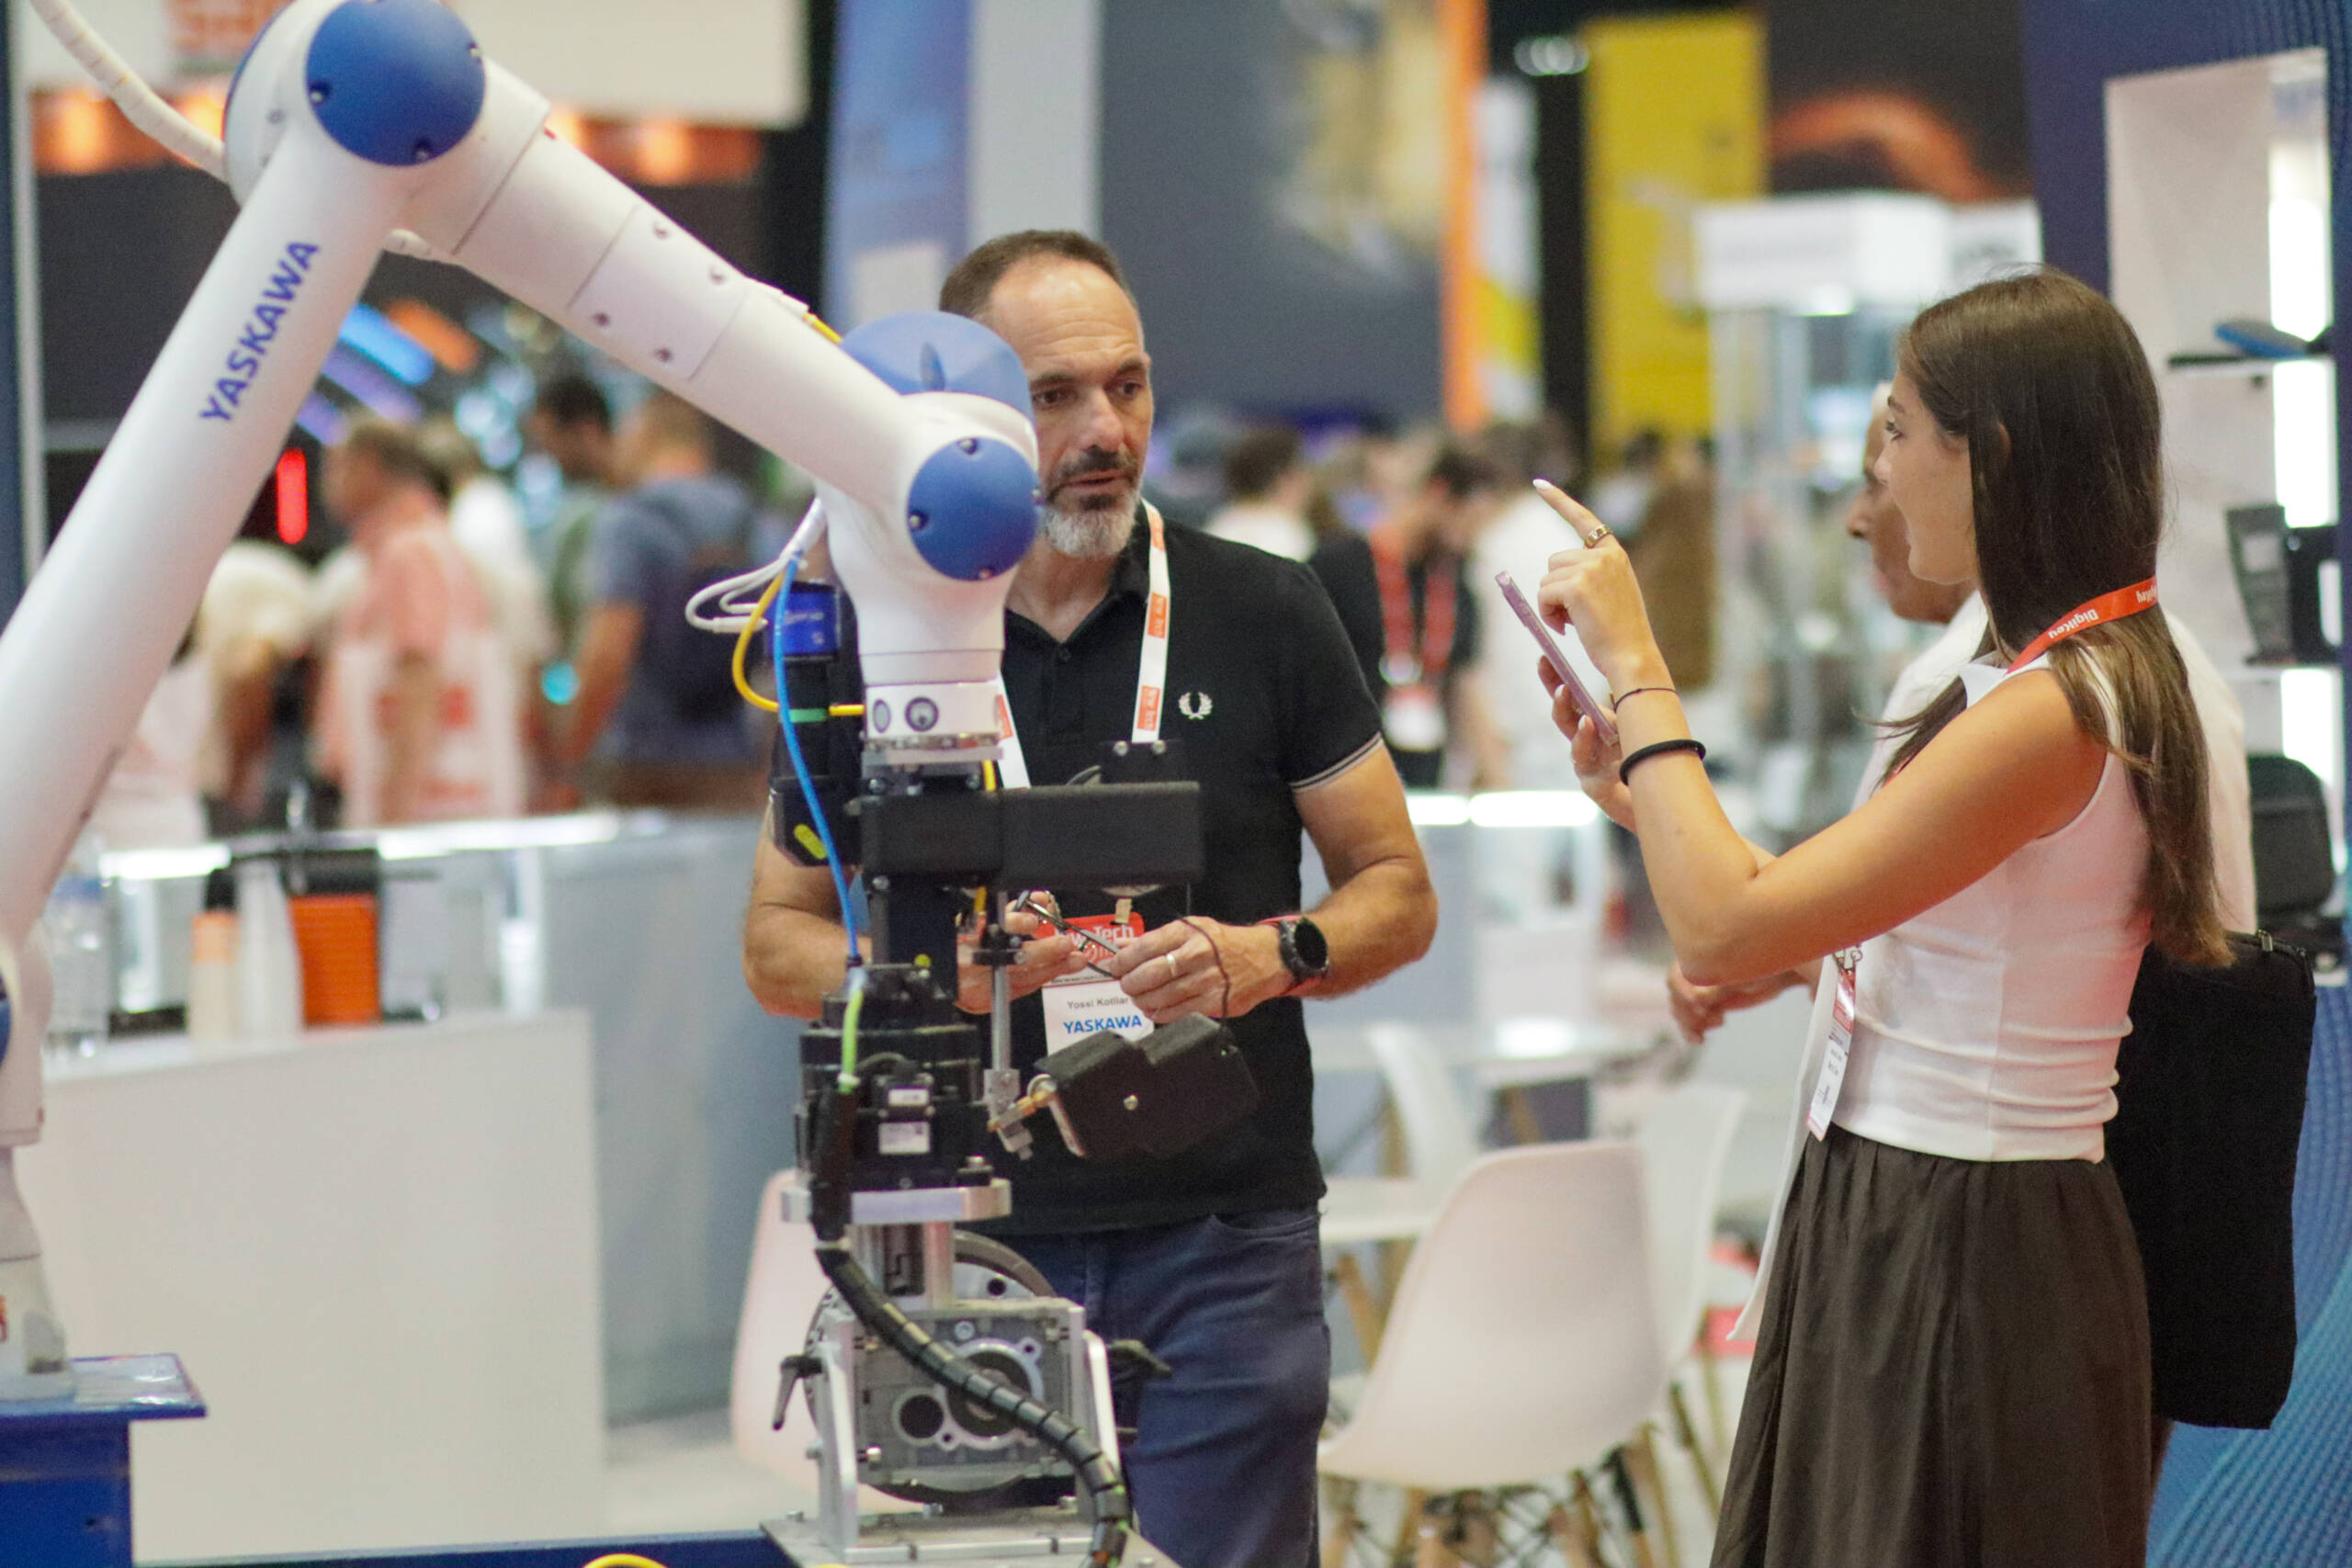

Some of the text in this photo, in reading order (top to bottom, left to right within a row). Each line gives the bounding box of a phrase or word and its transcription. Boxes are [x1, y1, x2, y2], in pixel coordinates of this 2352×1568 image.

[198, 243, 319, 421] YASKAWA
[1093, 924, 1135, 945] Tech
[1063, 1015, 1142, 1034] YASKAWA
